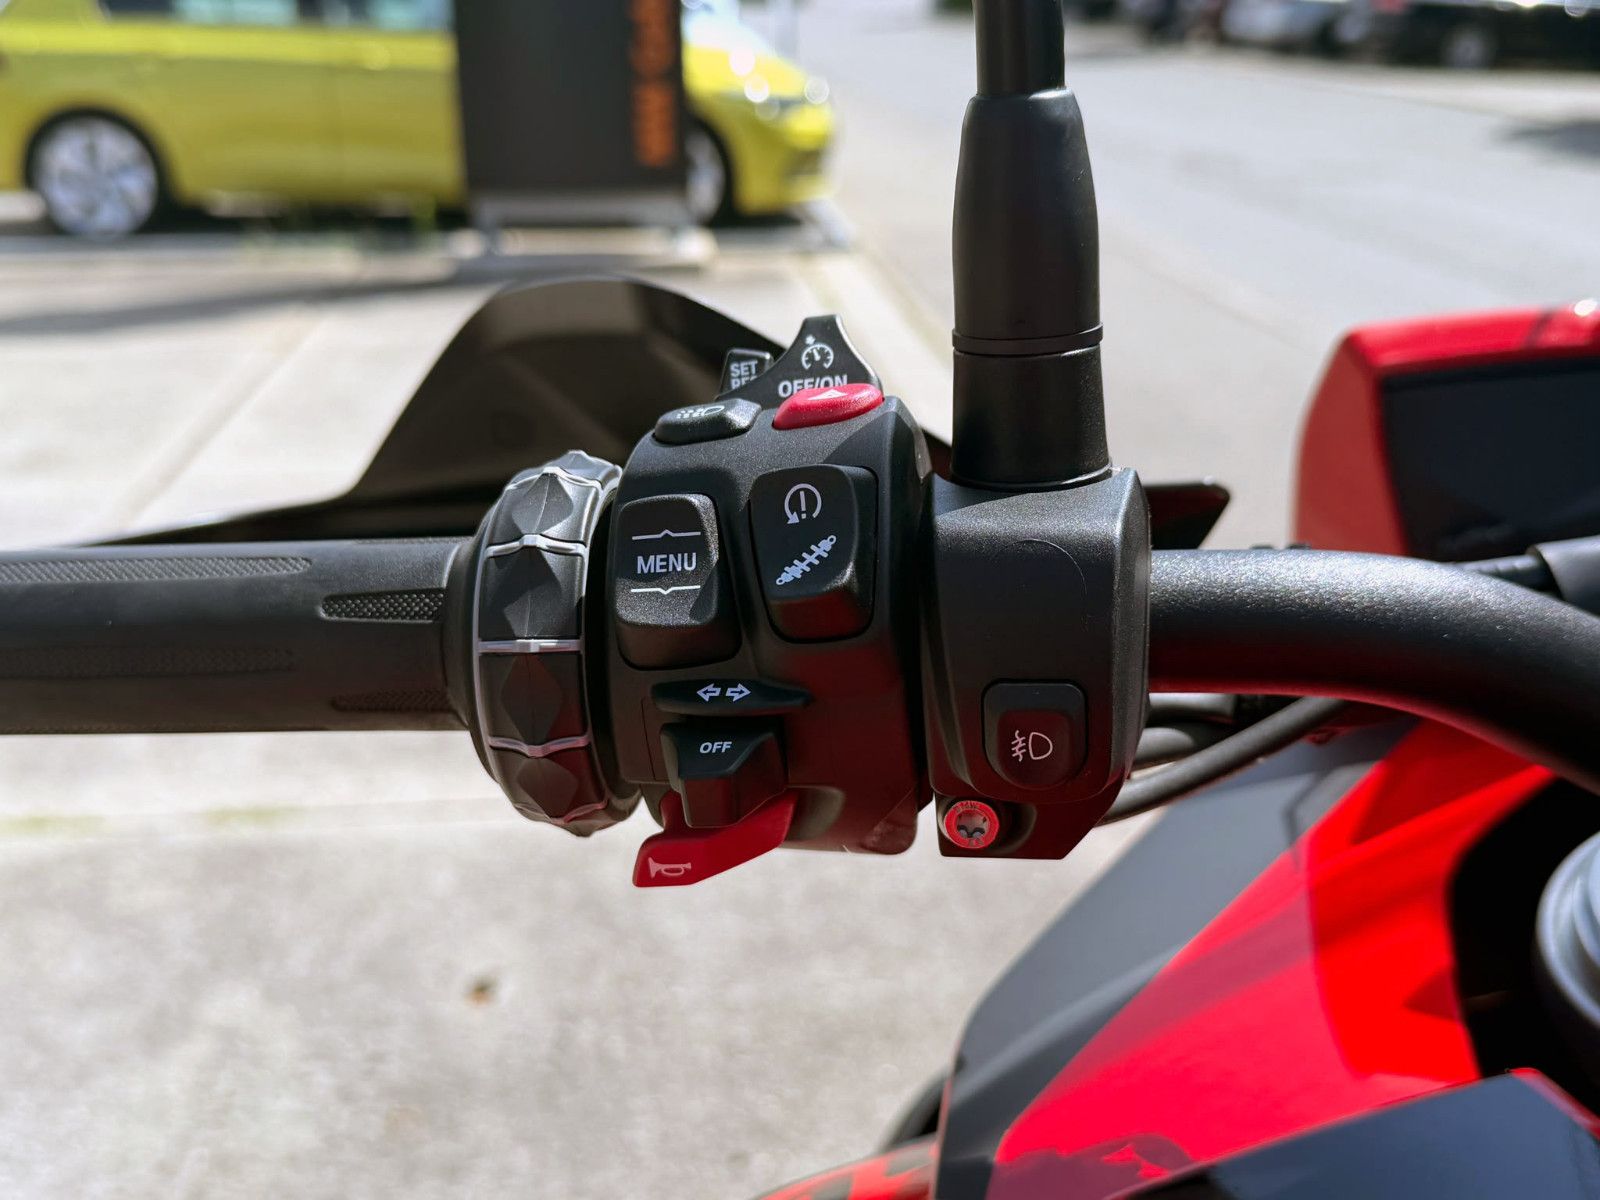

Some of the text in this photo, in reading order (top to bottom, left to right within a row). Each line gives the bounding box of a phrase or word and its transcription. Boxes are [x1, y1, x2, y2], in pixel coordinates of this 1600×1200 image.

[730, 360, 758, 377] SET
[636, 552, 697, 574] MENU
[700, 741, 732, 754] OFF
